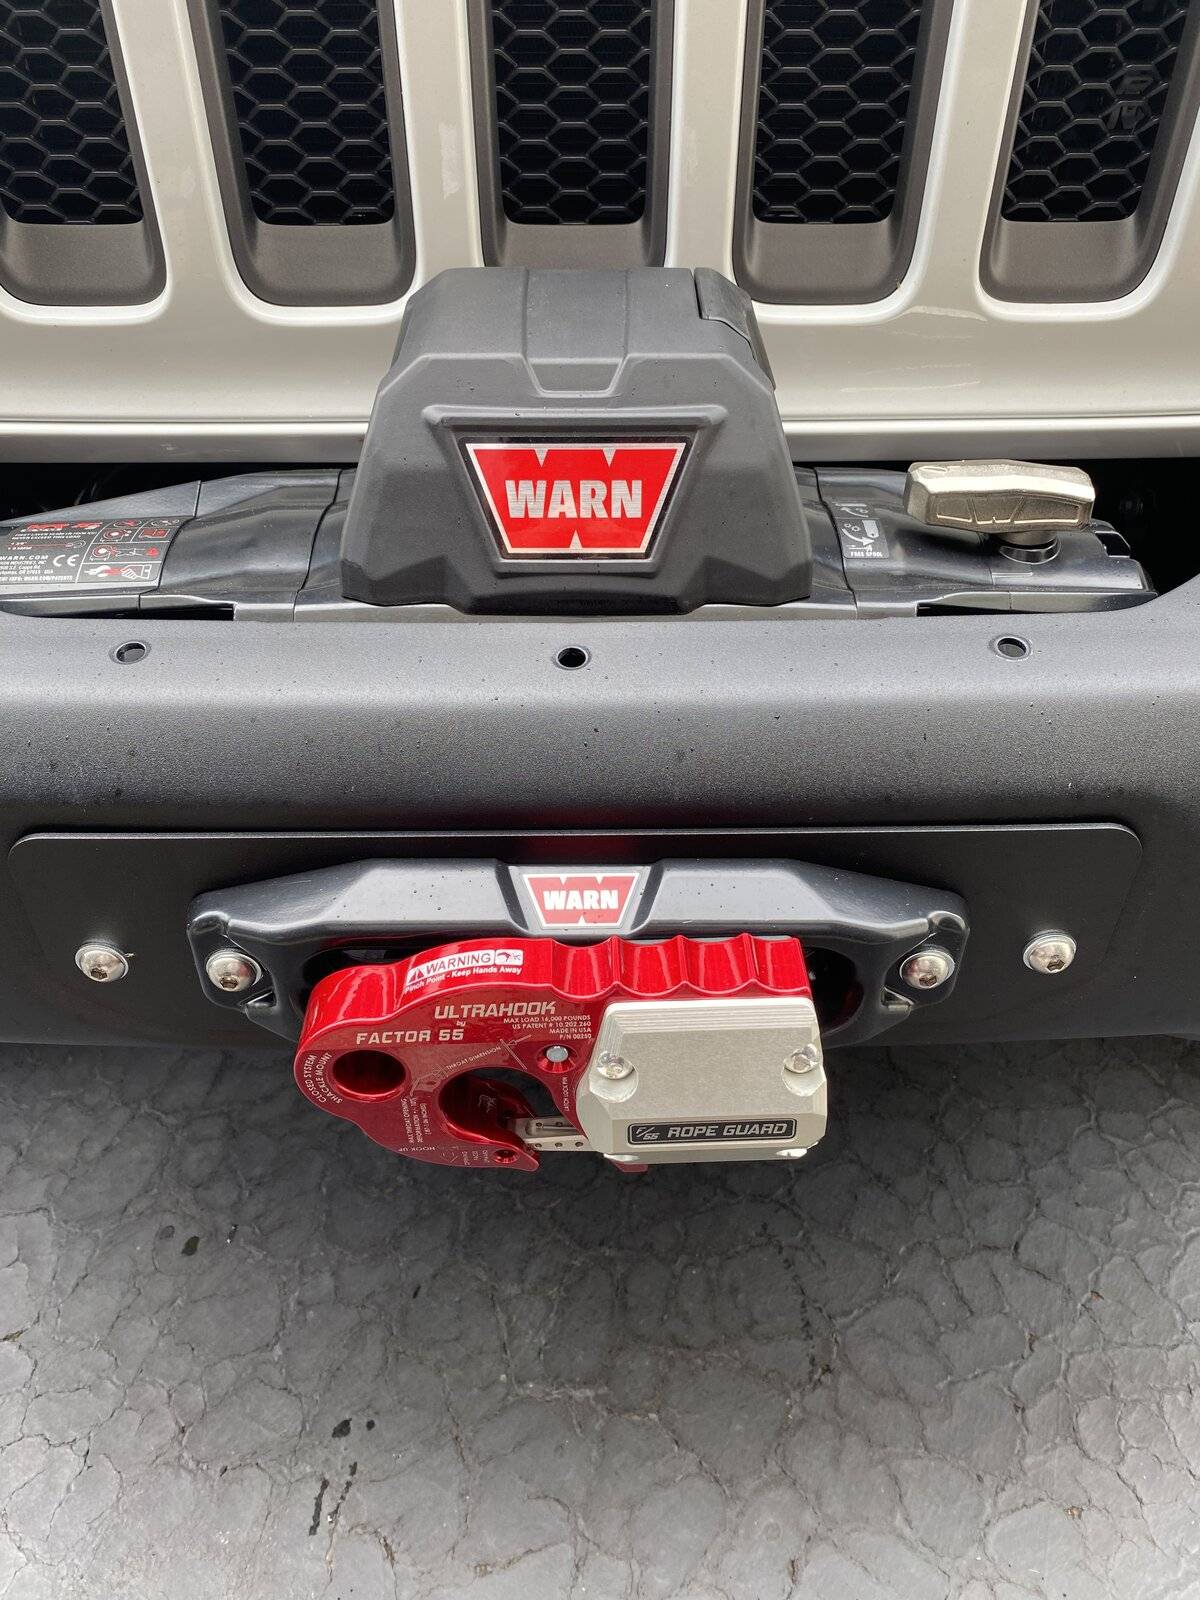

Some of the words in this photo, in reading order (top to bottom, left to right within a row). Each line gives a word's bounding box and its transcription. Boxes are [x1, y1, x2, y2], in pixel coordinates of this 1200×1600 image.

[505, 480, 642, 518] WARN
[543, 889, 618, 911] WARN
[425, 952, 492, 976] WARNING
[404, 981, 424, 995] Pinch
[426, 972, 445, 985] Point
[451, 967, 471, 978] Keep
[473, 965, 497, 974] Hands
[499, 965, 522, 975] Away
[434, 1001, 556, 1020] ULTRAHOOK
[456, 1020, 466, 1028] by
[356, 1030, 431, 1045] FACTOR
[439, 1028, 464, 1041] 55
[303, 1054, 316, 1078] SYSTEM
[315, 1052, 332, 1076] MOUNT
[305, 1079, 327, 1103] CLOSED
[315, 1077, 342, 1104] SHACKLE
[667, 1125, 719, 1138] ROPE
[722, 1123, 788, 1136] GUARD
